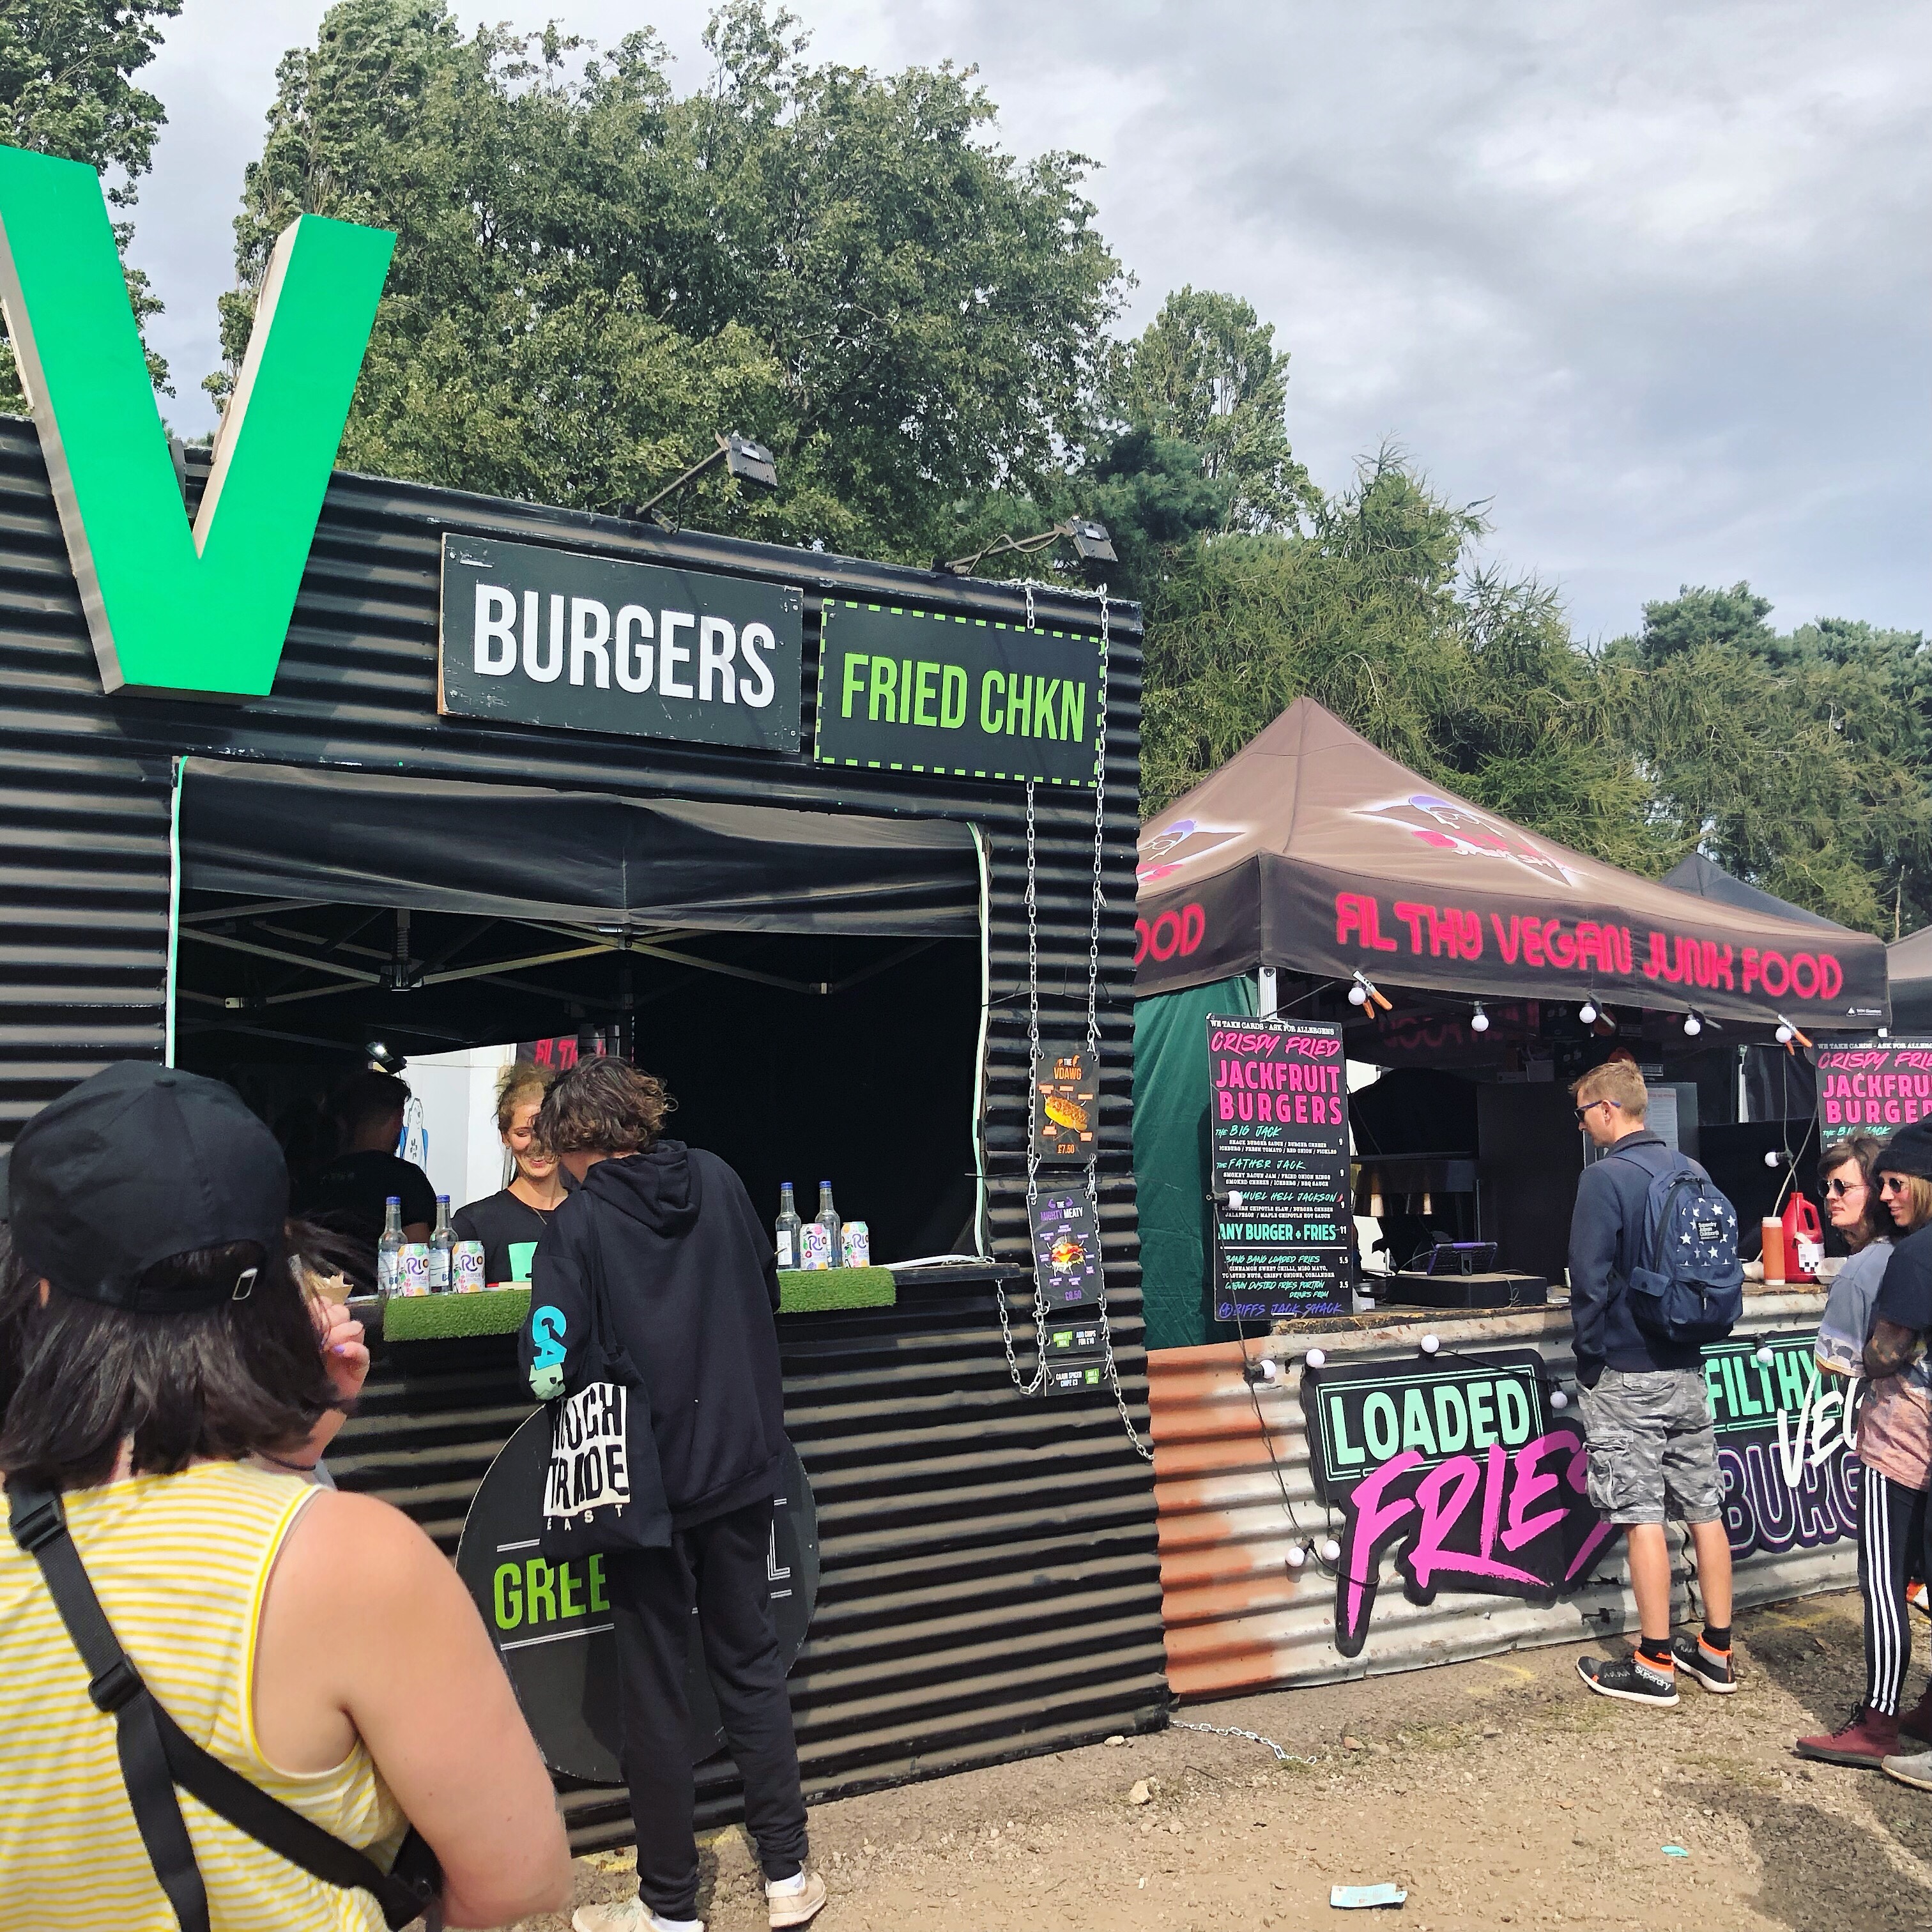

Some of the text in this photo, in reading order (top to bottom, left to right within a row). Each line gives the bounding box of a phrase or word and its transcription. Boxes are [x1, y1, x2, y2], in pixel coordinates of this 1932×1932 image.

[0, 146, 397, 696] V
[473, 583, 776, 709] BURGERS
[841, 652, 1085, 742] FRIED CHKN
[1134, 903, 1206, 967] OOD
[1335, 892, 1844, 1000] FILTHY VEGAN JUNK FOOD
[1211, 1020, 1222, 1028] WE
[1222, 1020, 1241, 1029] TAKE
[1241, 1022, 1264, 1031] CARDS
[1268, 1023, 1282, 1032] ASK
[1283, 1024, 1296, 1032] FOR
[1297, 1025, 1335, 1035] ALLERGENS
[1211, 1031, 1341, 1062] CRISPY FRIED
[1063, 1058, 1073, 1066] THE
[1817, 1052, 1890, 1072] CRISPY
[1054, 1067, 1082, 1080] VDAWG
[1216, 1059, 1341, 1094] JACKFRUIT
[1219, 1091, 1342, 1125] BURGERS
[1215, 1125, 1282, 1140] THE BIG JACK
[1822, 1130, 1836, 1138] THE
[1057, 1144, 1075, 1154] £7.50
[1228, 1158, 1271, 1170] FATHER
[1276, 1160, 1306, 1170] JACK
[1239, 1191, 1338, 1202] MUEL HELL JACKSON
[1039, 1207, 1083, 1222] MIGHTY MEATY
[1218, 1223, 1244, 1240] ANY
[1245, 1223, 1293, 1241] BURGER
[1303, 1224, 1337, 1241] FRIES
[406, 1257, 429, 1275] RIO
[461, 1254, 483, 1272] RIO
[1246, 1255, 1268, 1266] BANG
[1268, 1255, 1296, 1266] LOADED
[1298, 1255, 1321, 1265] FRIES
[1338, 1256, 1349, 1264] 5.5
[1247, 1281, 1277, 1291] DUSTED
[1277, 1280, 1298, 1291] FRIES
[1339, 1280, 1349, 1289] 3.5
[553, 1384, 622, 1452] UGH
[1330, 1379, 1531, 1466] LOADED
[551, 1445, 630, 1510] TRADE
[546, 1504, 624, 1531] EAST
[494, 1552, 610, 1630] GREE
[1635, 1666, 1671, 1691] Superdry
